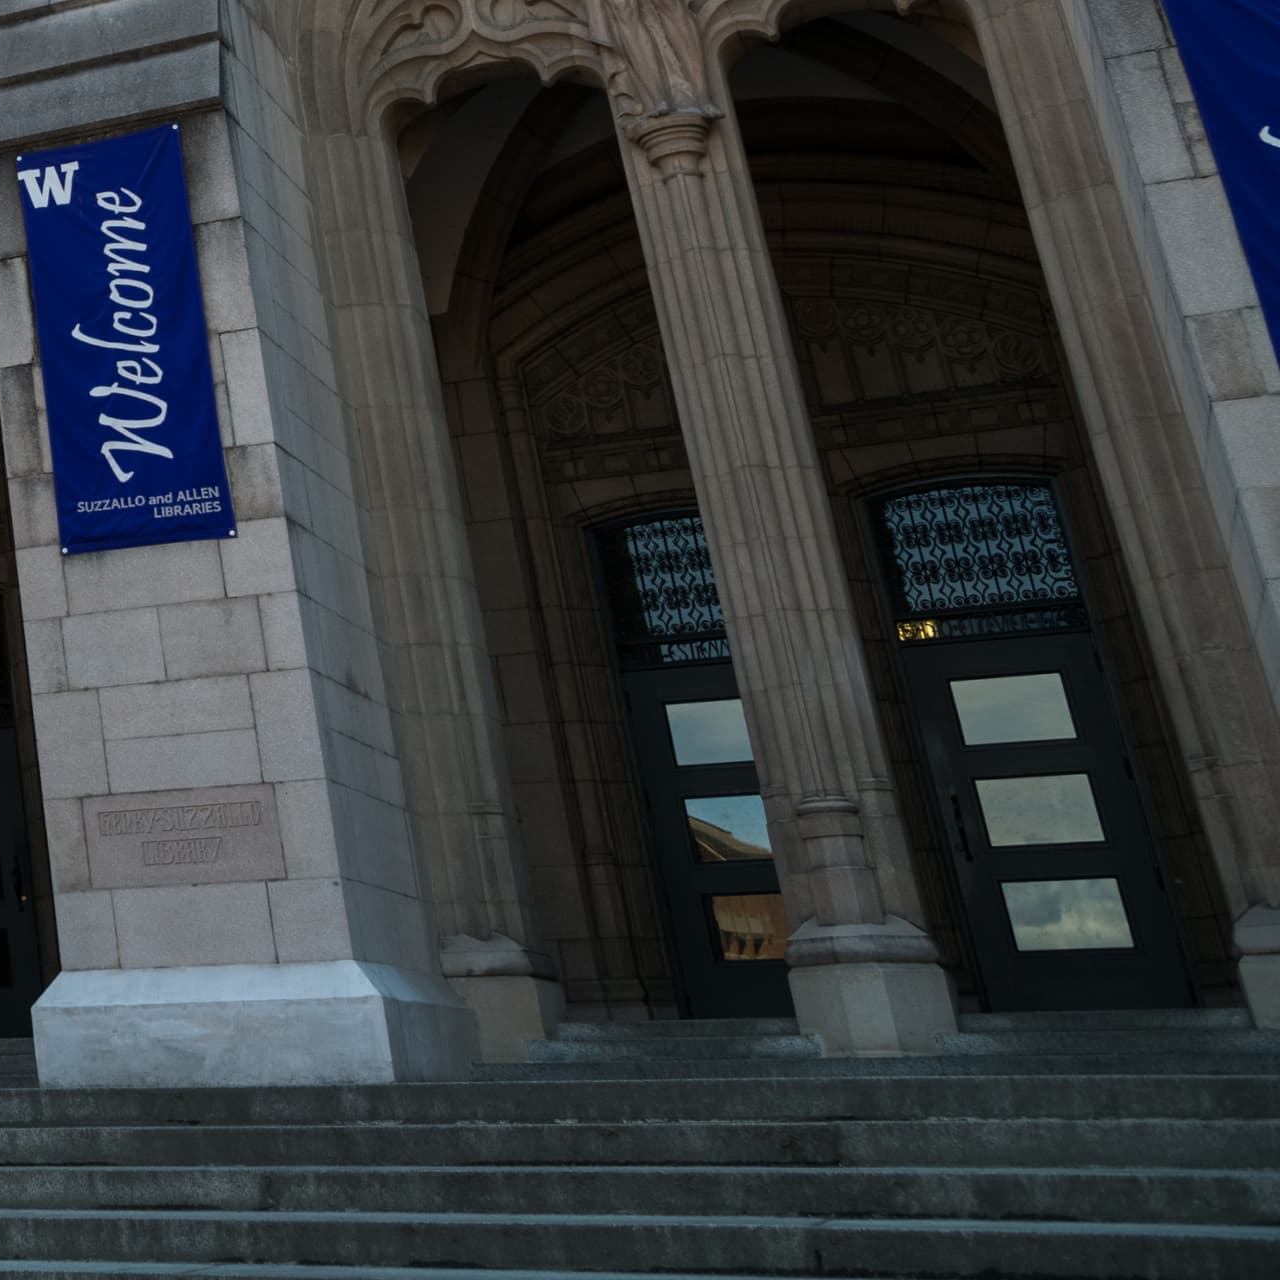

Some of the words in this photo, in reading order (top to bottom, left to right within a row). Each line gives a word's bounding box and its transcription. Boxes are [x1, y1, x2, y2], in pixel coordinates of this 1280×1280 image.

[17, 161, 79, 209] W
[71, 186, 174, 483] Welcome
[77, 495, 145, 513] SUZZALLO
[148, 492, 173, 505] and
[176, 486, 220, 502] ALLEN
[153, 501, 222, 518] LIBRARIES
